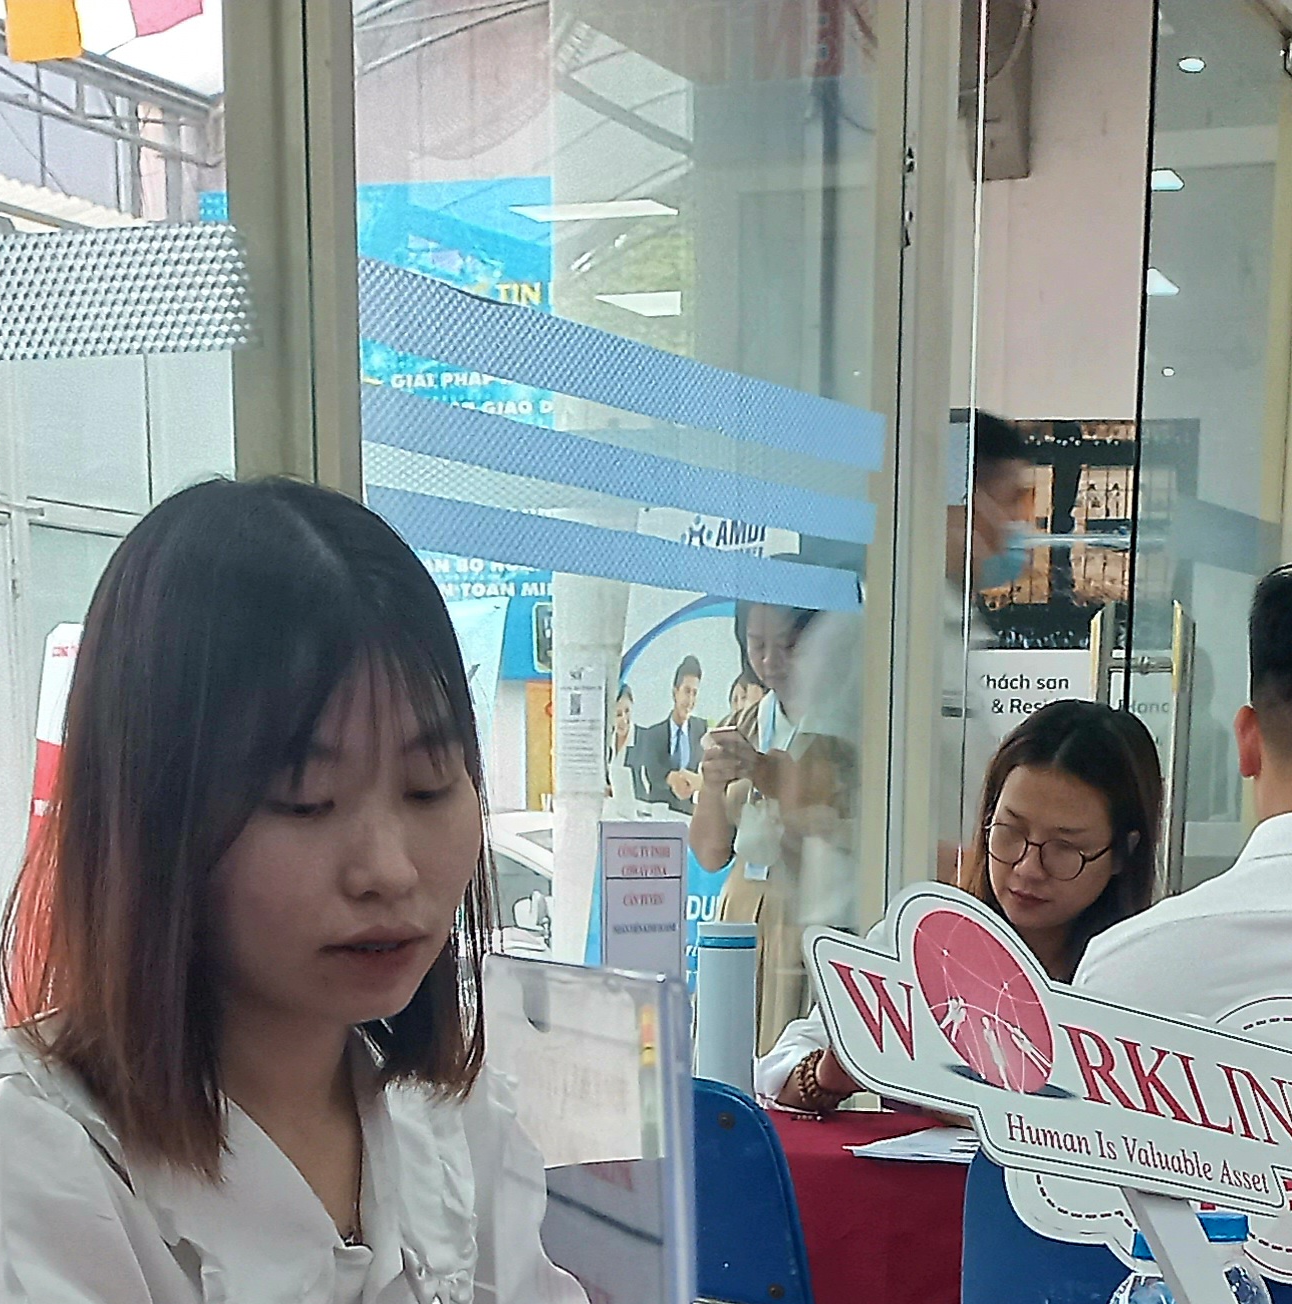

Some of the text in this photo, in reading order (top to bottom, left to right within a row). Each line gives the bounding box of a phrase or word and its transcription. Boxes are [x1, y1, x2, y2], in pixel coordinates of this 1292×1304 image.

[992, 699, 1004, 714] &
[1005, 1112, 1270, 1194] Human Is Valuable Asset
